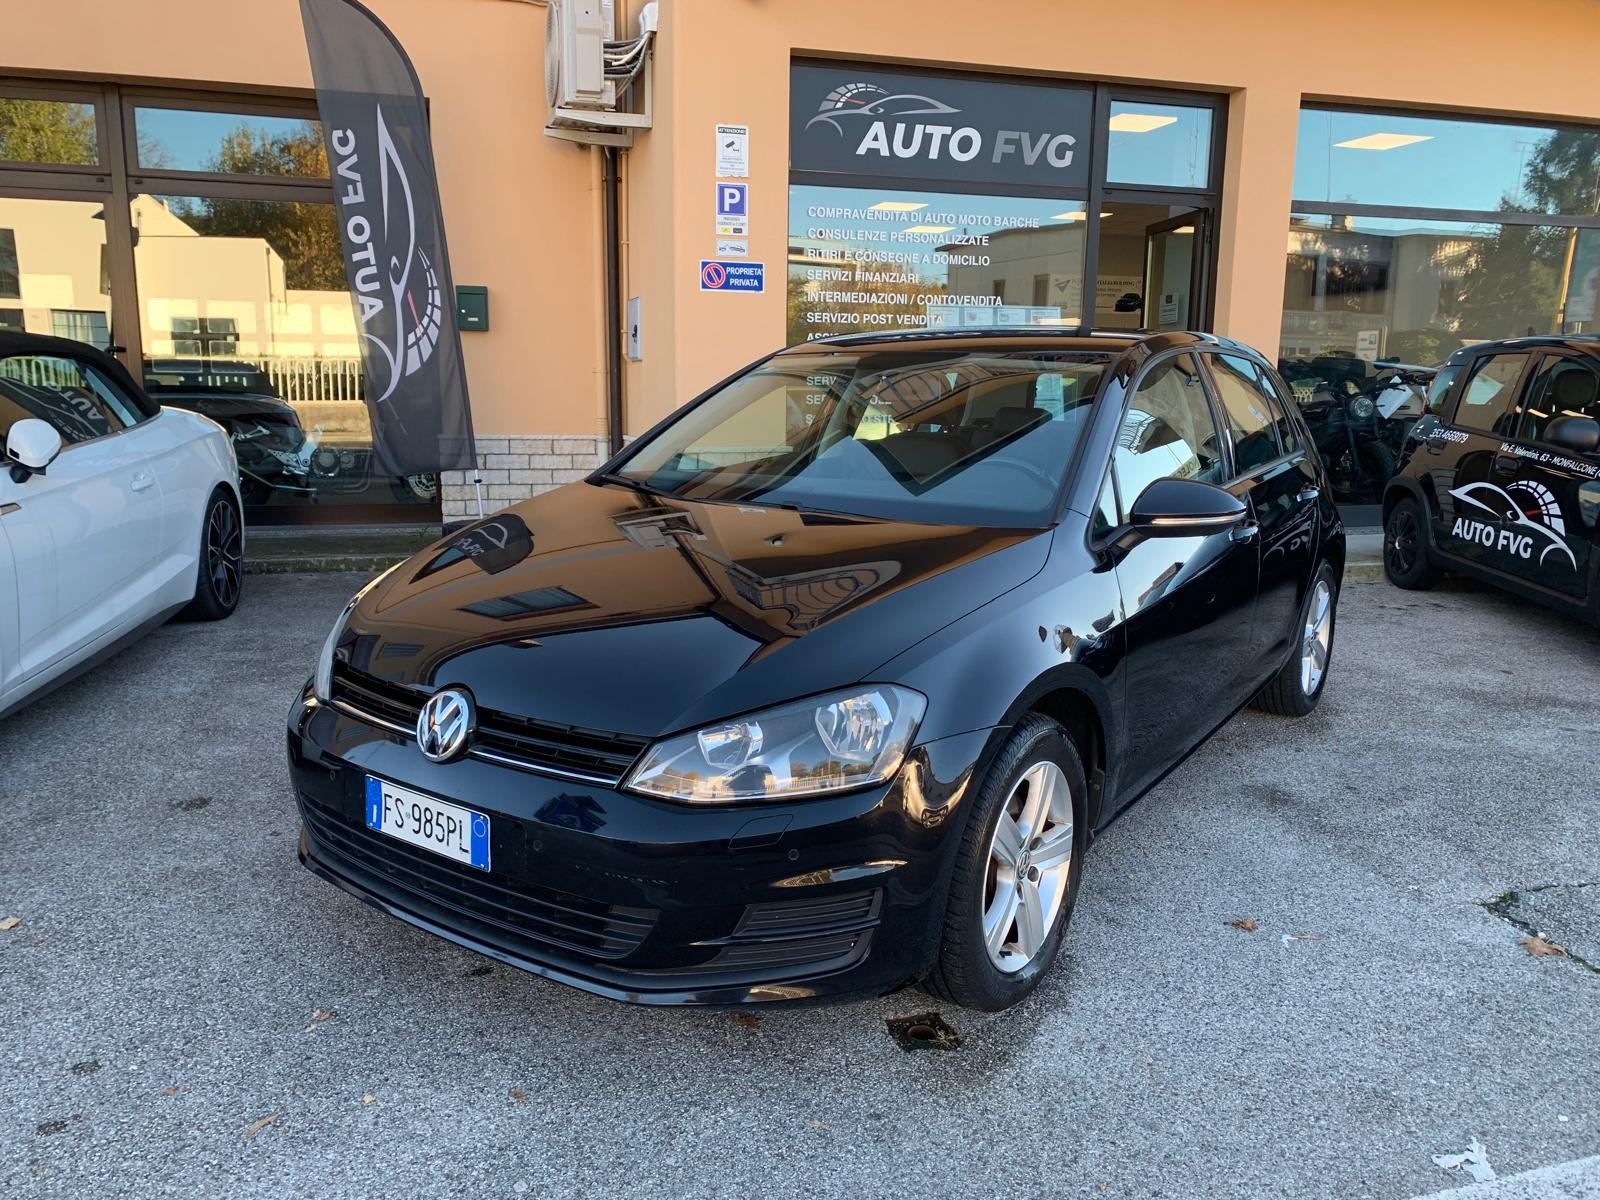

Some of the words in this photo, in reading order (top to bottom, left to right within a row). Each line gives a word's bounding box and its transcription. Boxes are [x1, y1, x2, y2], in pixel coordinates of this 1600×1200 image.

[855, 121, 982, 162] AUTO
[991, 130, 1077, 168] FVG
[723, 187, 741, 212] P
[808, 206, 907, 221] COMPRAVENDITA
[910, 211, 922, 222] DI
[924, 212, 956, 224] AUTO
[959, 214, 991, 226] MOTO
[994, 215, 1040, 228] BARCHE
[808, 227, 887, 241] CONSULENZE
[890, 231, 990, 246] PERSONALIZZATE
[808, 248, 842, 260] RITIRI
[845, 250, 853, 261] E
[855, 250, 919, 263] CONSEGNE
[922, 253, 930, 265] A
[933, 254, 990, 266] DOMICILIO
[730, 278, 759, 287] PRIVATA
[807, 269, 852, 281] SERVIZI
[855, 271, 919, 284] FINANZIARI
[807, 291, 908, 306] INTERMEDIAZIONI
[917, 294, 1003, 307] CONTOVENDITA
[806, 312, 860, 325] SERVIZIO
[863, 313, 894, 325] POST
[896, 314, 944, 327] VENDITA
[1540, 453, 1550, 462] 63
[1551, 456, 1598, 475] MONFALCONE
[1452, 517, 1495, 547] AUTO
[1497, 530, 1533, 559] FVG
[384, 793, 404, 829] FS
[411, 804, 469, 853] 985PL
